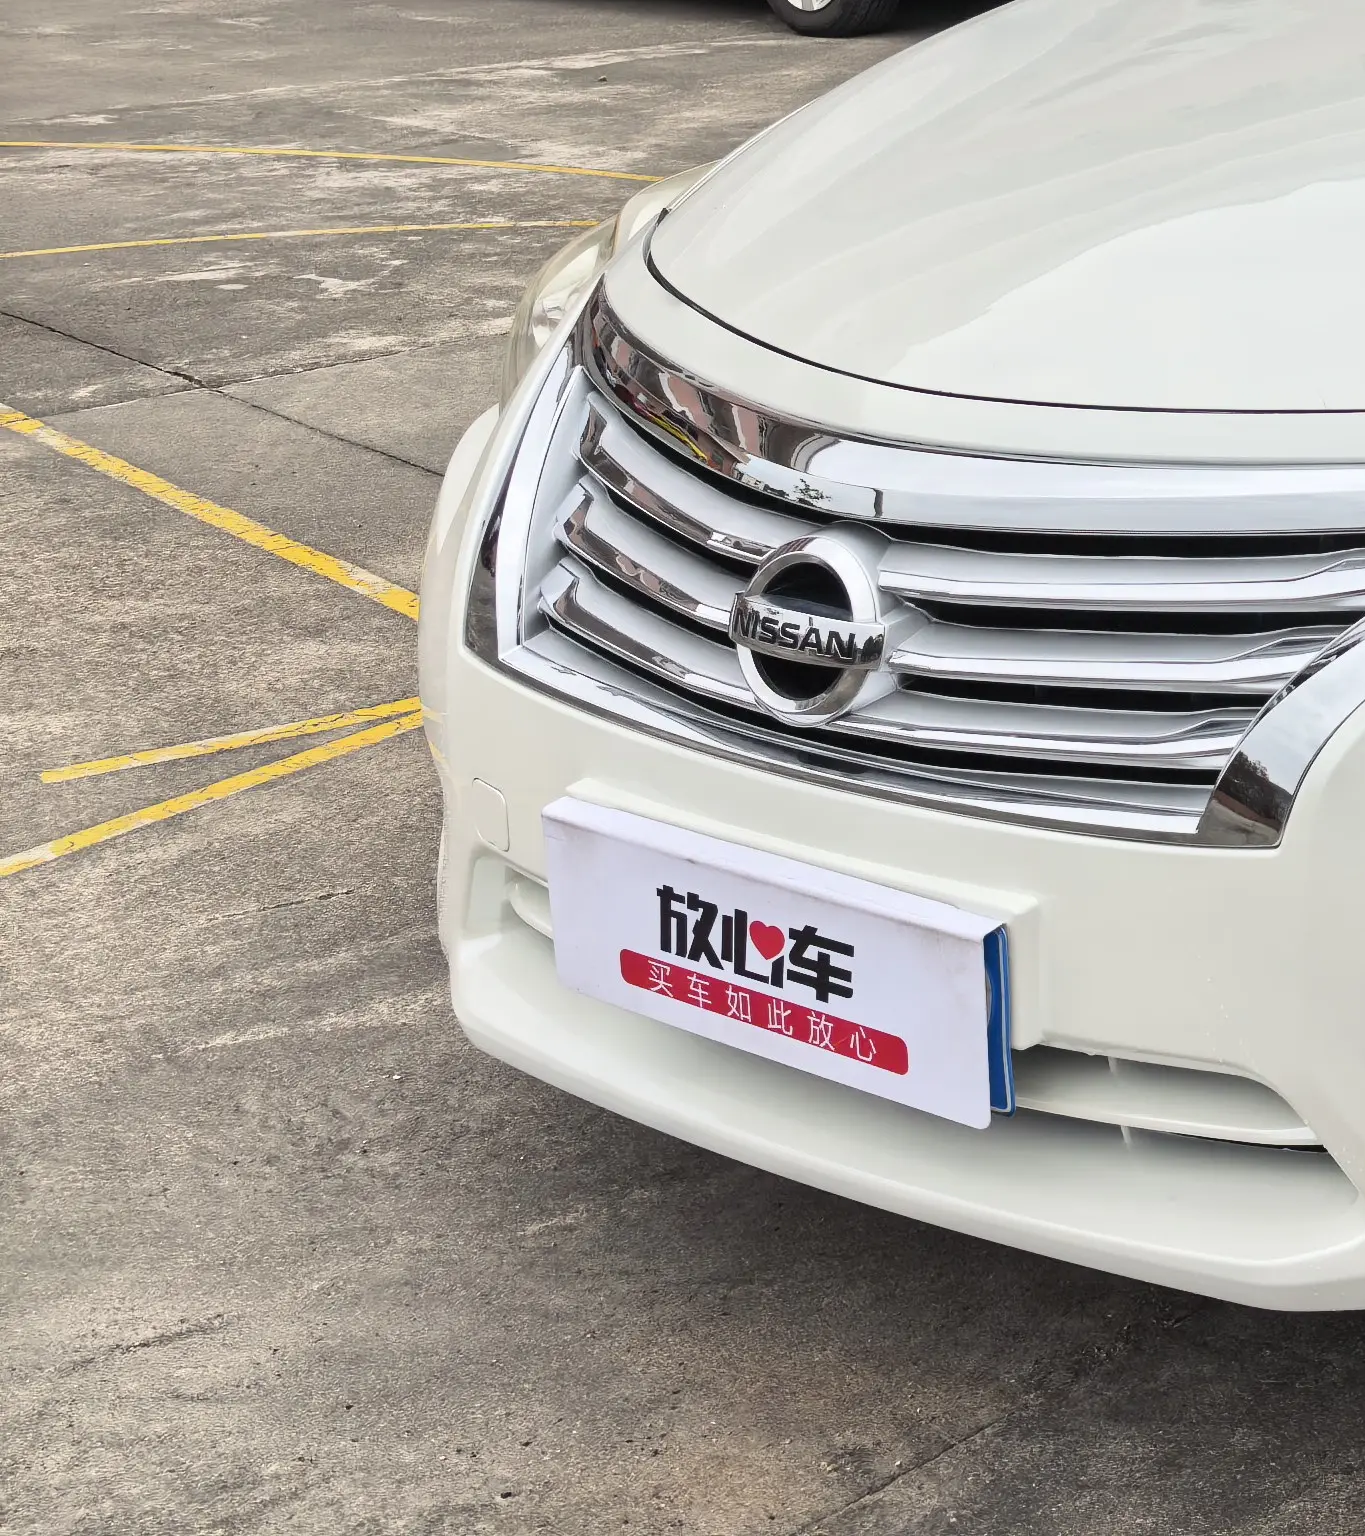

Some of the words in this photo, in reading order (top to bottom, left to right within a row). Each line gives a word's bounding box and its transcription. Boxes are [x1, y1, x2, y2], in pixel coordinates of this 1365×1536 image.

[733, 607, 857, 664] NISSAN
[656, 884, 855, 1004] 放心车
[647, 959, 877, 1062] 买车如此放心
